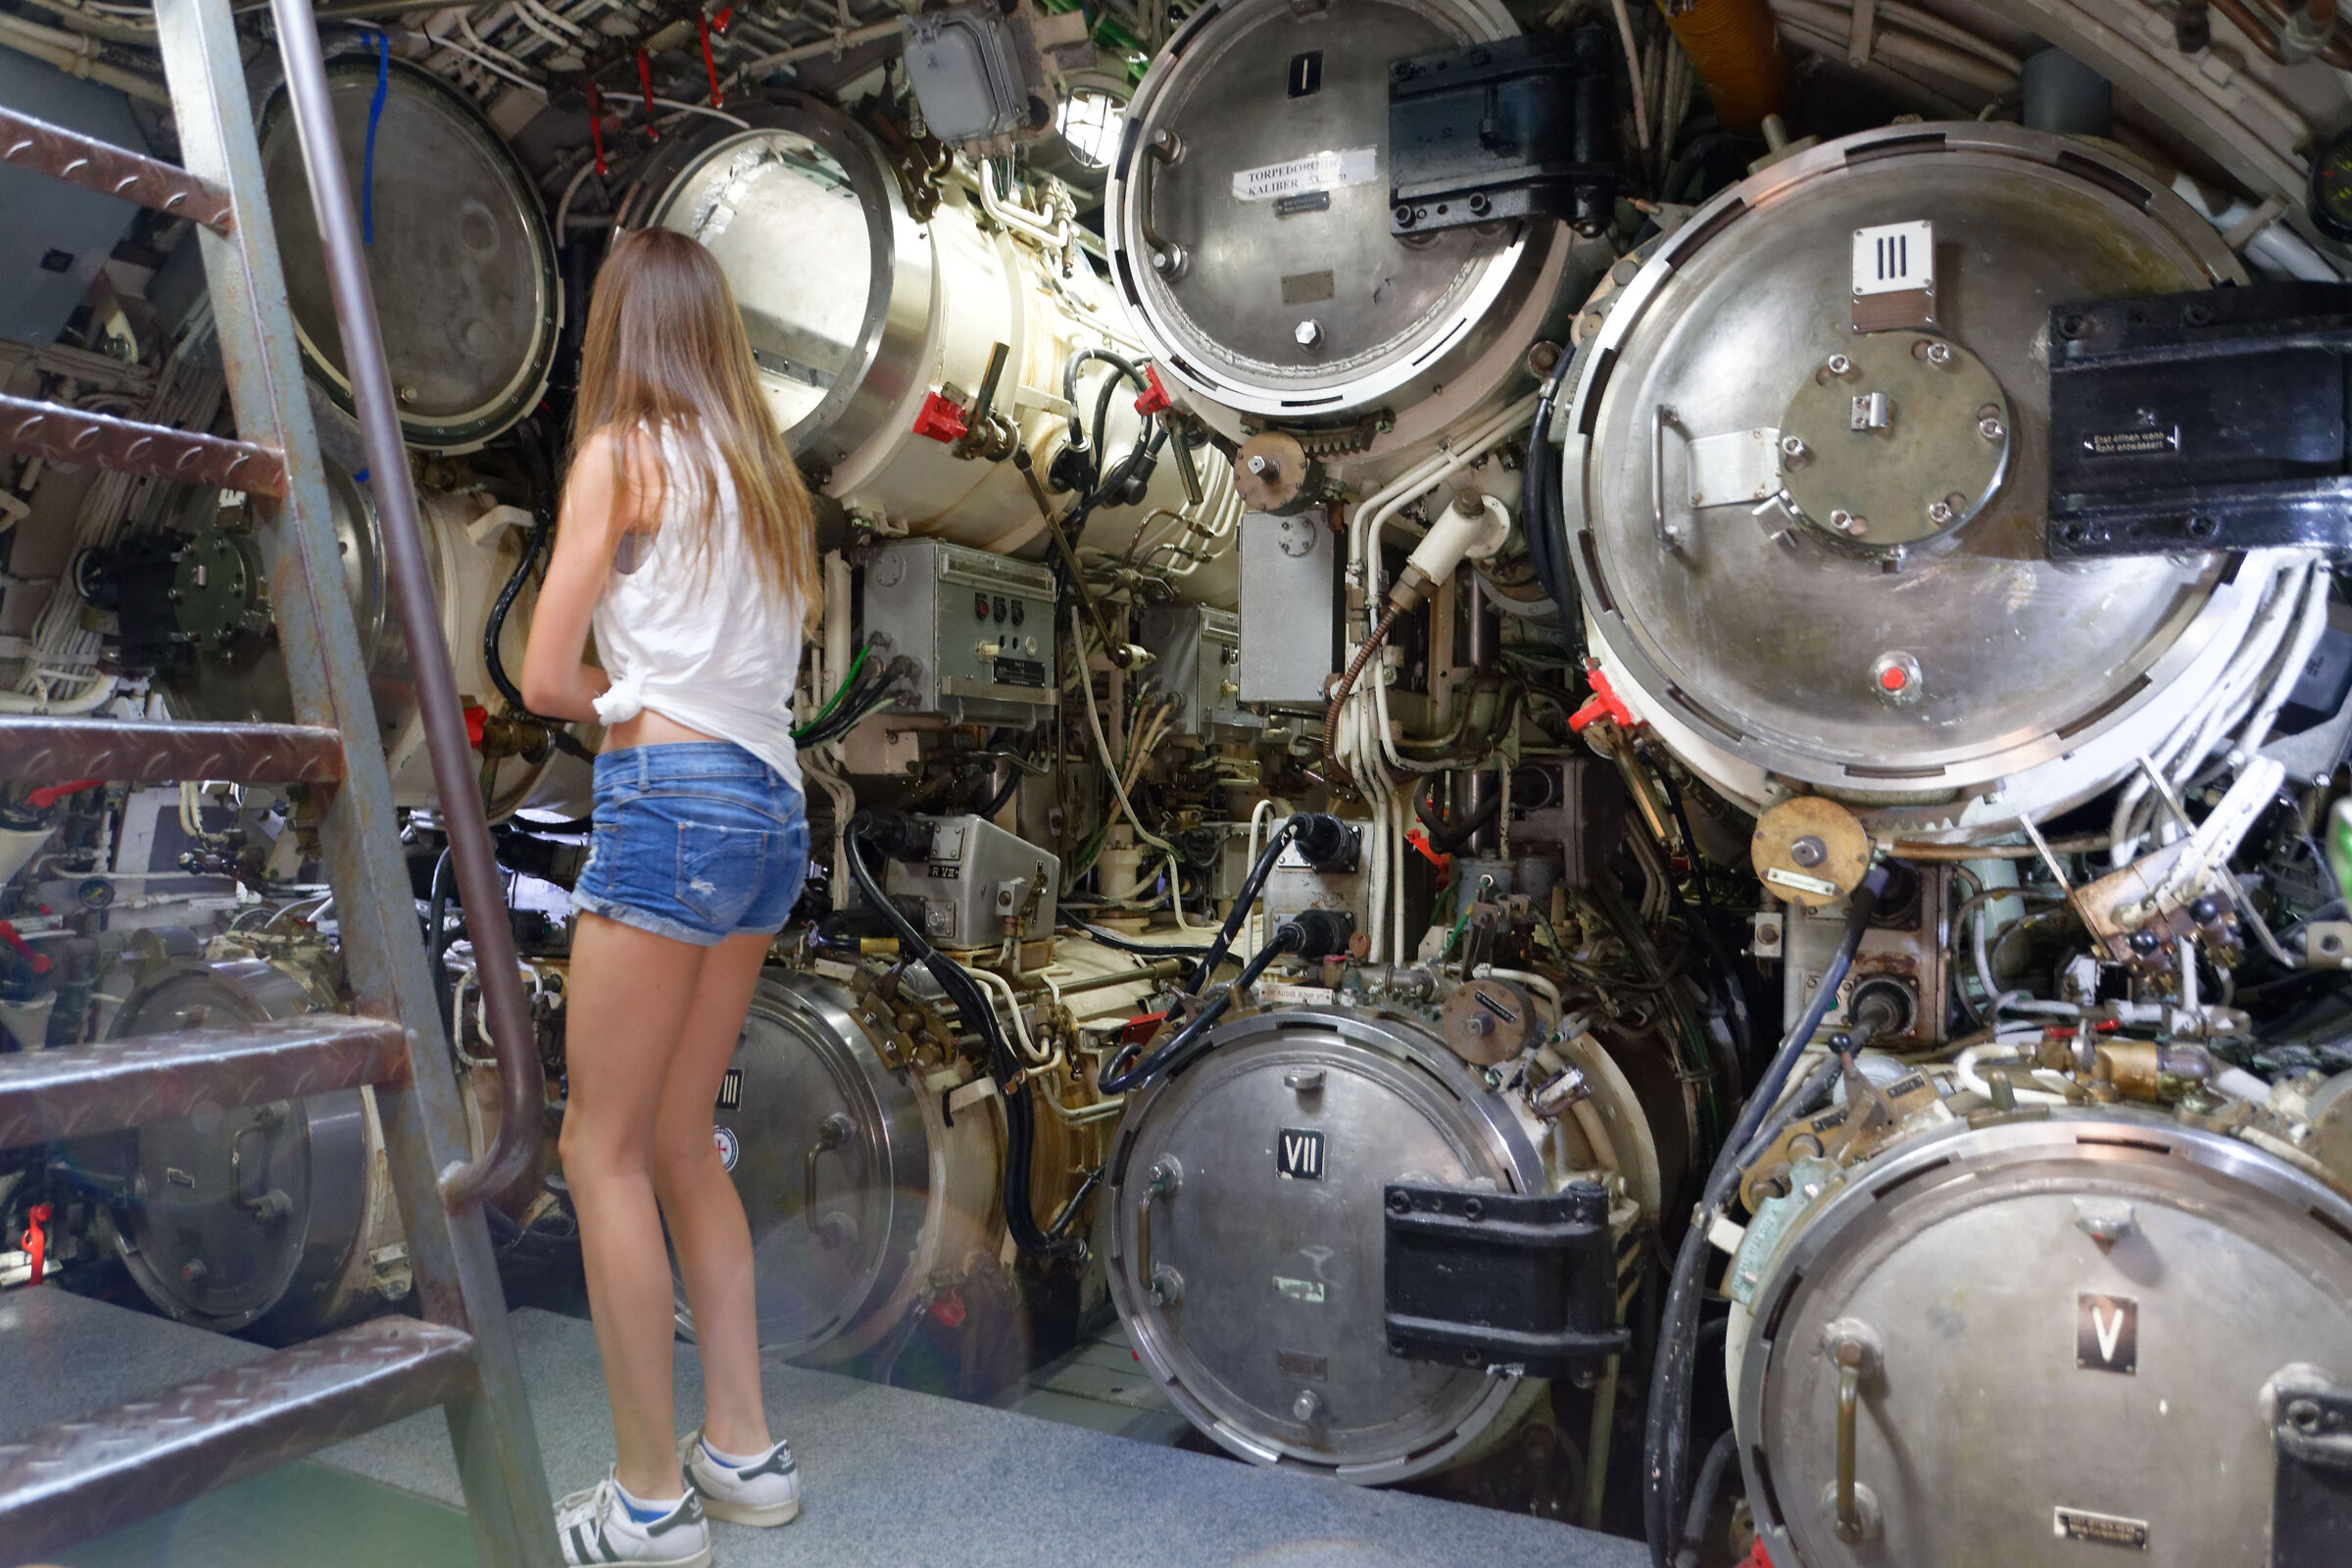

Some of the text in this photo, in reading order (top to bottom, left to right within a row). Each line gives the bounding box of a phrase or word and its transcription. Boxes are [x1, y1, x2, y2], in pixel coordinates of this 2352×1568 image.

[1249, 179, 1298, 196] KALIBER
[1877, 234, 1907, 280] III
[932, 866, 939, 877] R
[1285, 1135, 1317, 1172] VII
[2091, 1305, 2125, 1363] V
